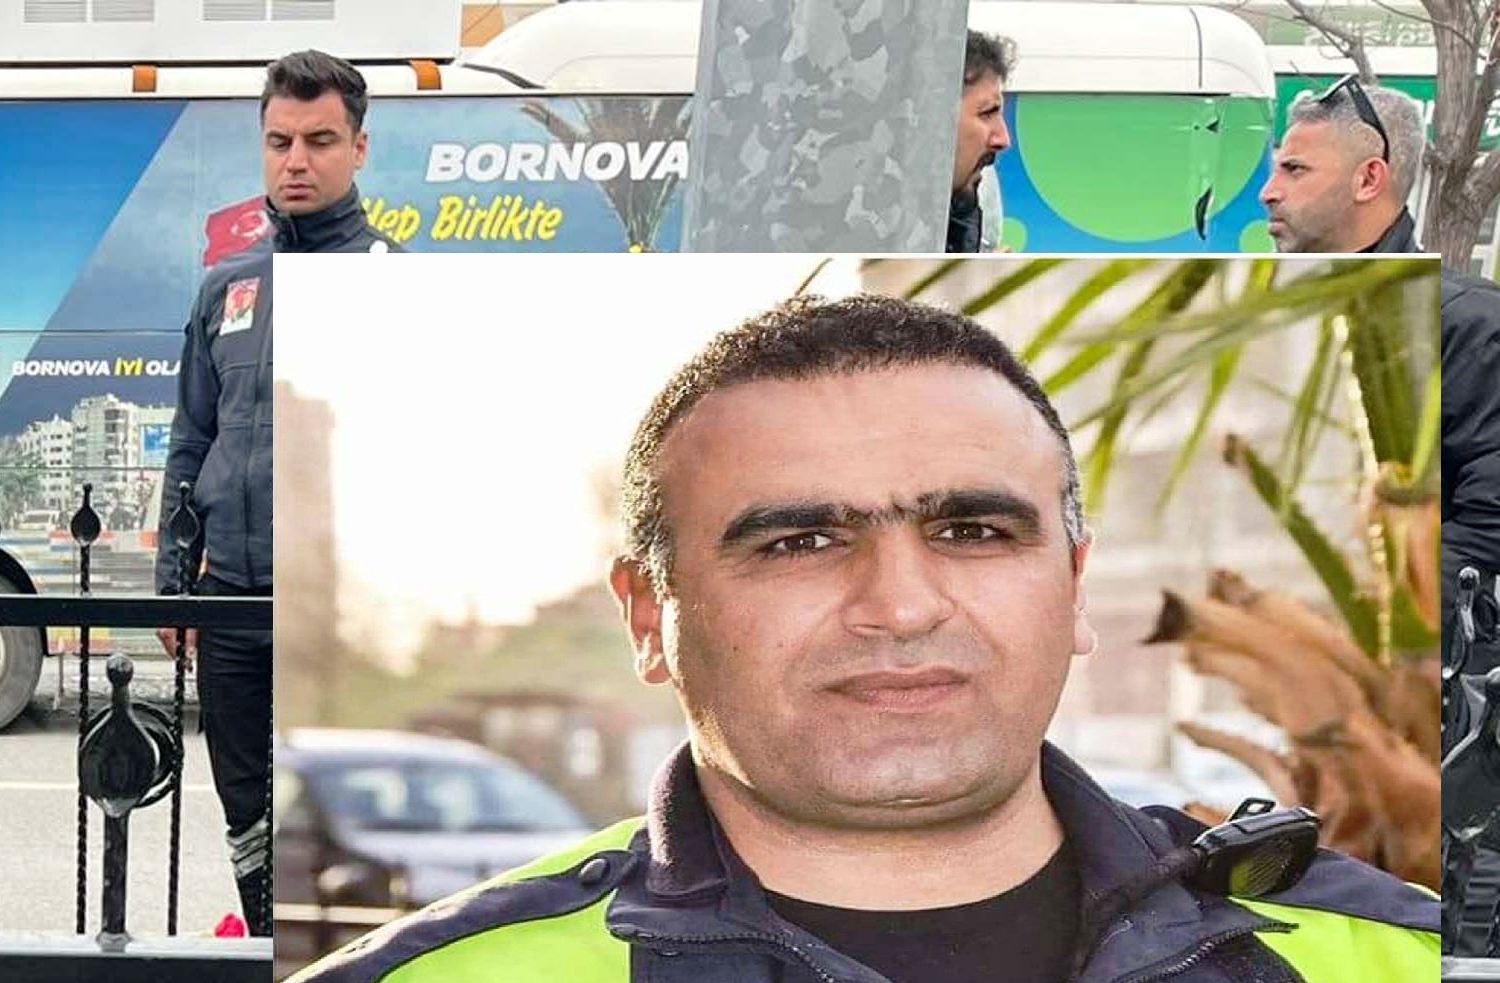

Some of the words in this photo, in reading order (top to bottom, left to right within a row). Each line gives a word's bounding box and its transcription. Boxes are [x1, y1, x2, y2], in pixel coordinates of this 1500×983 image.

[426, 141, 689, 182] BORNOVA
[430, 194, 563, 241] Birlikte
[11, 359, 111, 376] BORNOVA
